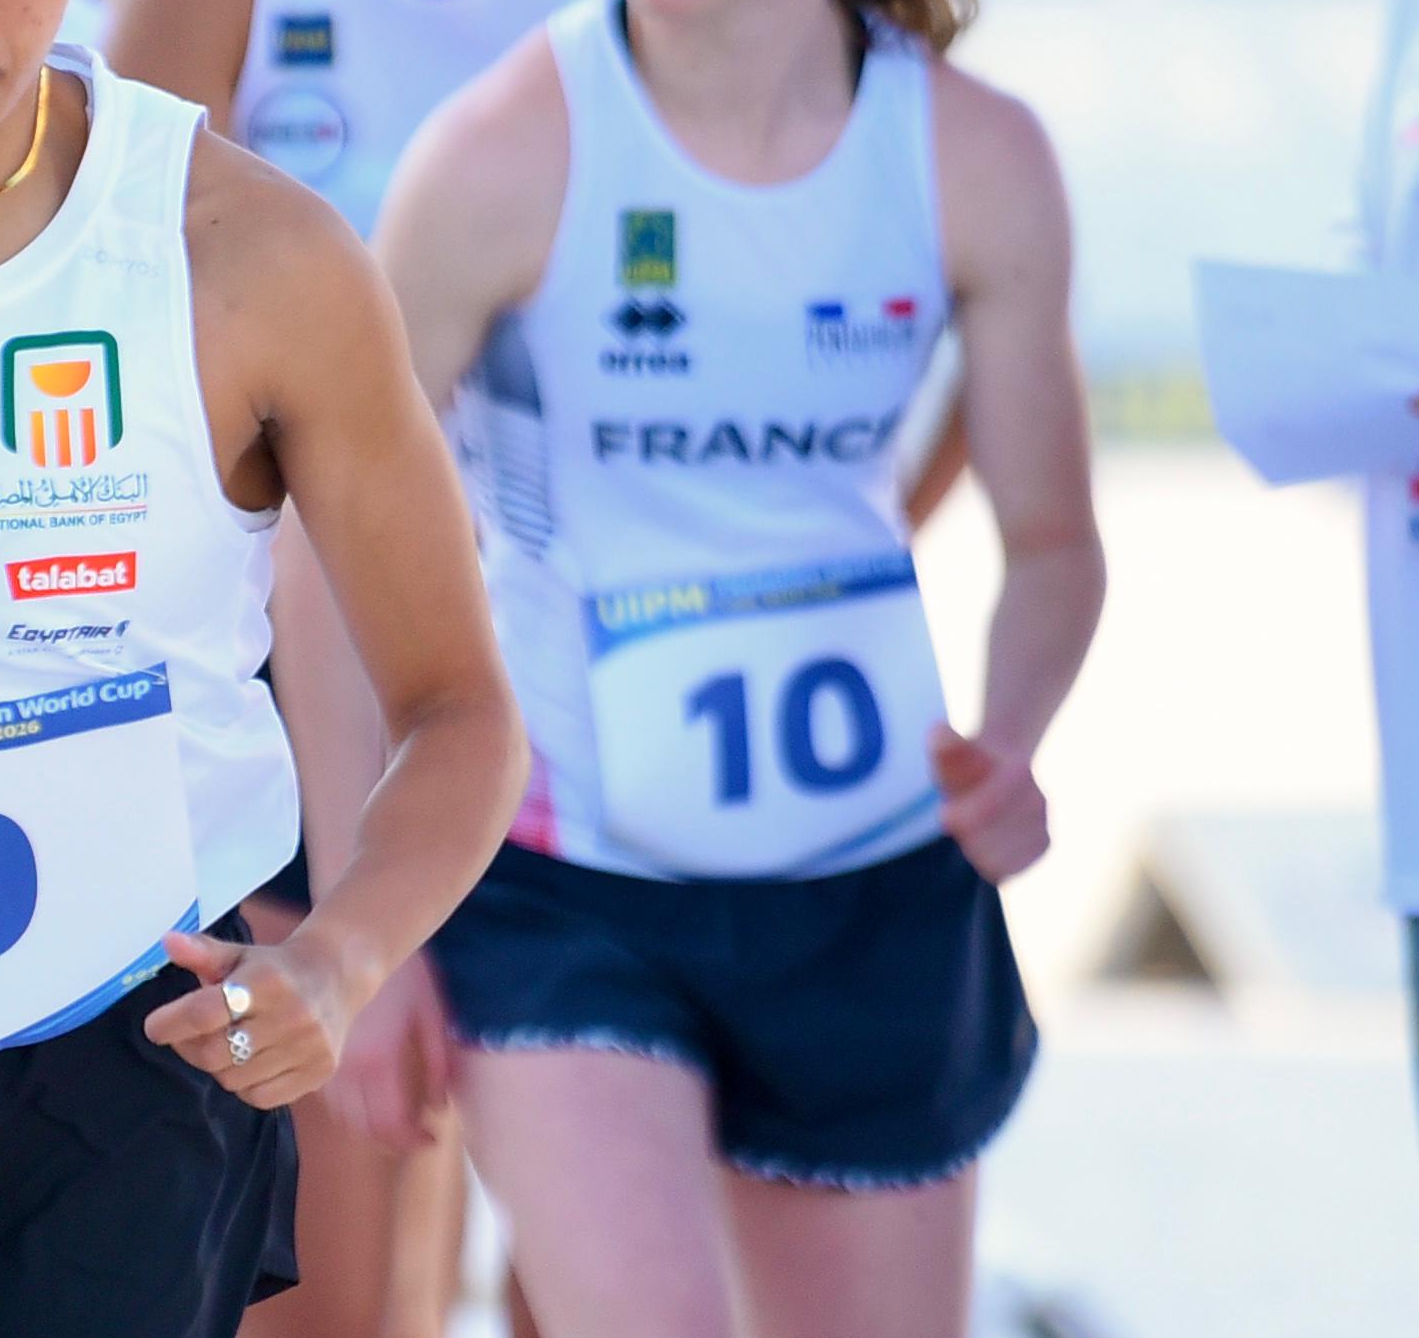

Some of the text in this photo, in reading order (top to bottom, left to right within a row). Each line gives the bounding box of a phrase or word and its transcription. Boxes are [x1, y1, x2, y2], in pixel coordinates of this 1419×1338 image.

[49, 515, 85, 528] BANK
[89, 514, 105, 525] OF
[109, 511, 148, 524] EGYPT
[17, 561, 127, 591] talabat
[597, 584, 708, 629] UIPM
[16, 685, 95, 720] World
[99, 678, 151, 703] Cup
[684, 656, 886, 806] 10
